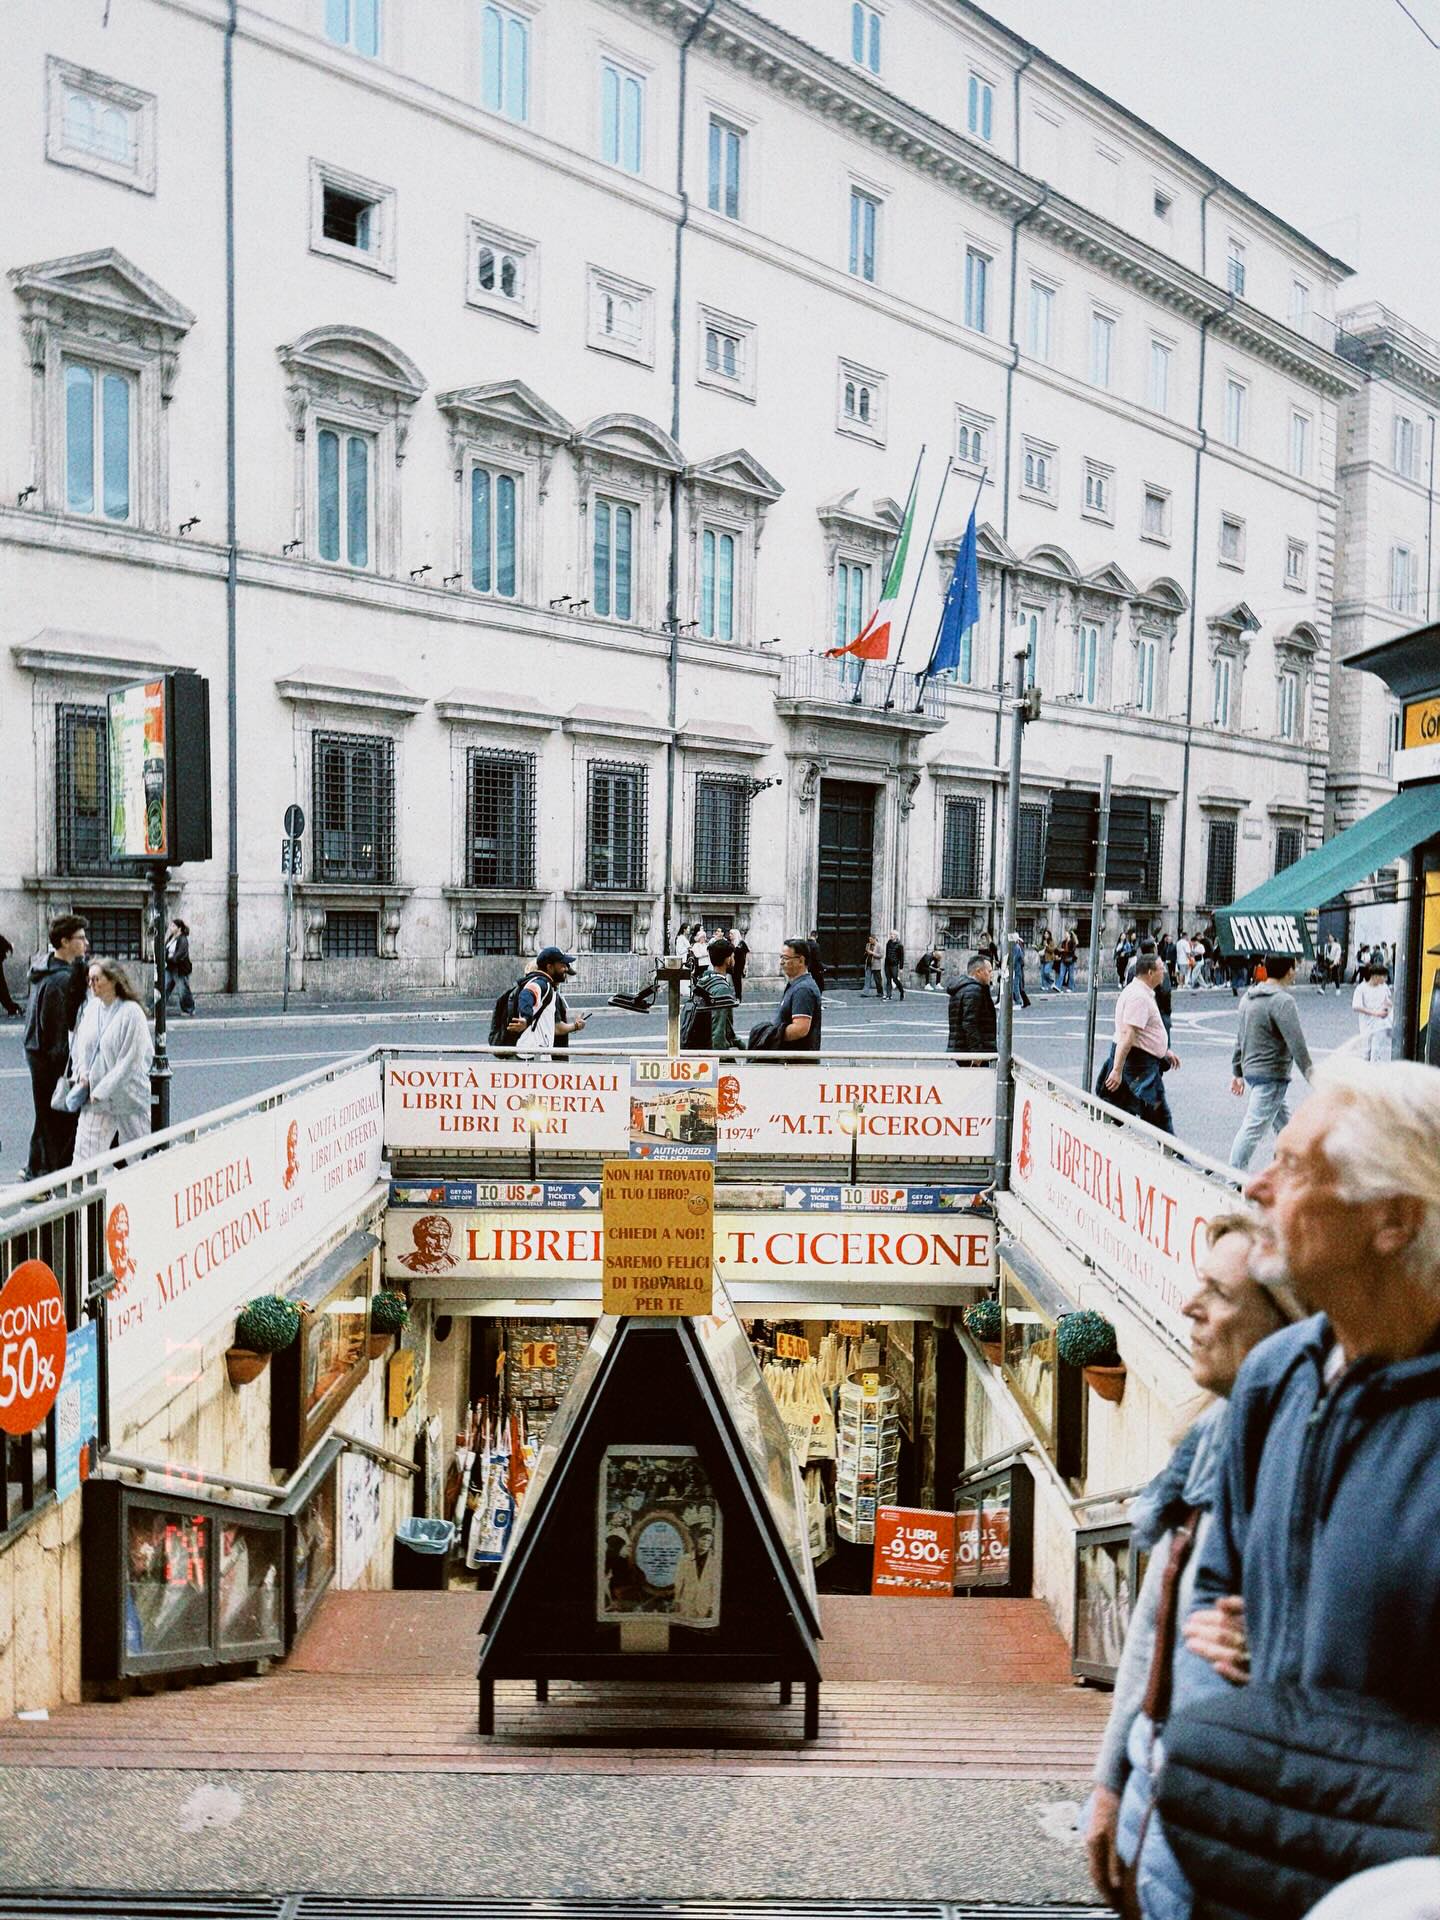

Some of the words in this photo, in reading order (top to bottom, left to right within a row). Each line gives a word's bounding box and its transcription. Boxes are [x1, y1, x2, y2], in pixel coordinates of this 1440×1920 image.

[1230, 916, 1268, 950] ATM
[1258, 916, 1304, 953] HERE
[389, 1067, 479, 1088] NOVITÀ
[490, 1072, 618, 1092] EDITORIALI
[401, 1093, 463, 1110] LIBRI
[472, 1094, 497, 1110] IN
[506, 1094, 605, 1113] OFERTA
[818, 1083, 943, 1105] LIBRERIA
[440, 1115, 500, 1132] LIBRI
[512, 1117, 568, 1134] RRI
[653, 1147, 711, 1156] AUTHORIZED
[346, 1151, 367, 1178] RARI
[606, 1169, 631, 1182] NON
[633, 1169, 654, 1181] HAI
[659, 1169, 711, 1182] TROVATO
[1049, 1122, 1127, 1223] LIBRERIA
[174, 1156, 253, 1229] LIBRERIA
[606, 1188, 618, 1200] IL
[621, 1188, 644, 1200] TUO
[647, 1188, 690, 1200] LIBRO?
[193, 1199, 271, 1280] CICERONE
[608, 1227, 657, 1240] CHIEDI
[662, 1227, 671, 1240] A
[675, 1228, 705, 1240] NOI!
[466, 1228, 602, 1263] LIBRE
[765, 1231, 990, 1268] CICERONE
[606, 1255, 663, 1269] SAREMO
[667, 1256, 710, 1269] FELICI
[612, 1276, 627, 1290] DI
[632, 1276, 704, 1290] TROVARLO
[635, 1297, 664, 1311] PER
[669, 1297, 685, 1311] TE
[0, 1296, 61, 1339] CONTO
[787, 1336, 808, 1361] 5.00
[0, 1336, 56, 1408] 50%
[895, 1526, 905, 1538] 2
[906, 1528, 938, 1542] LIBRI
